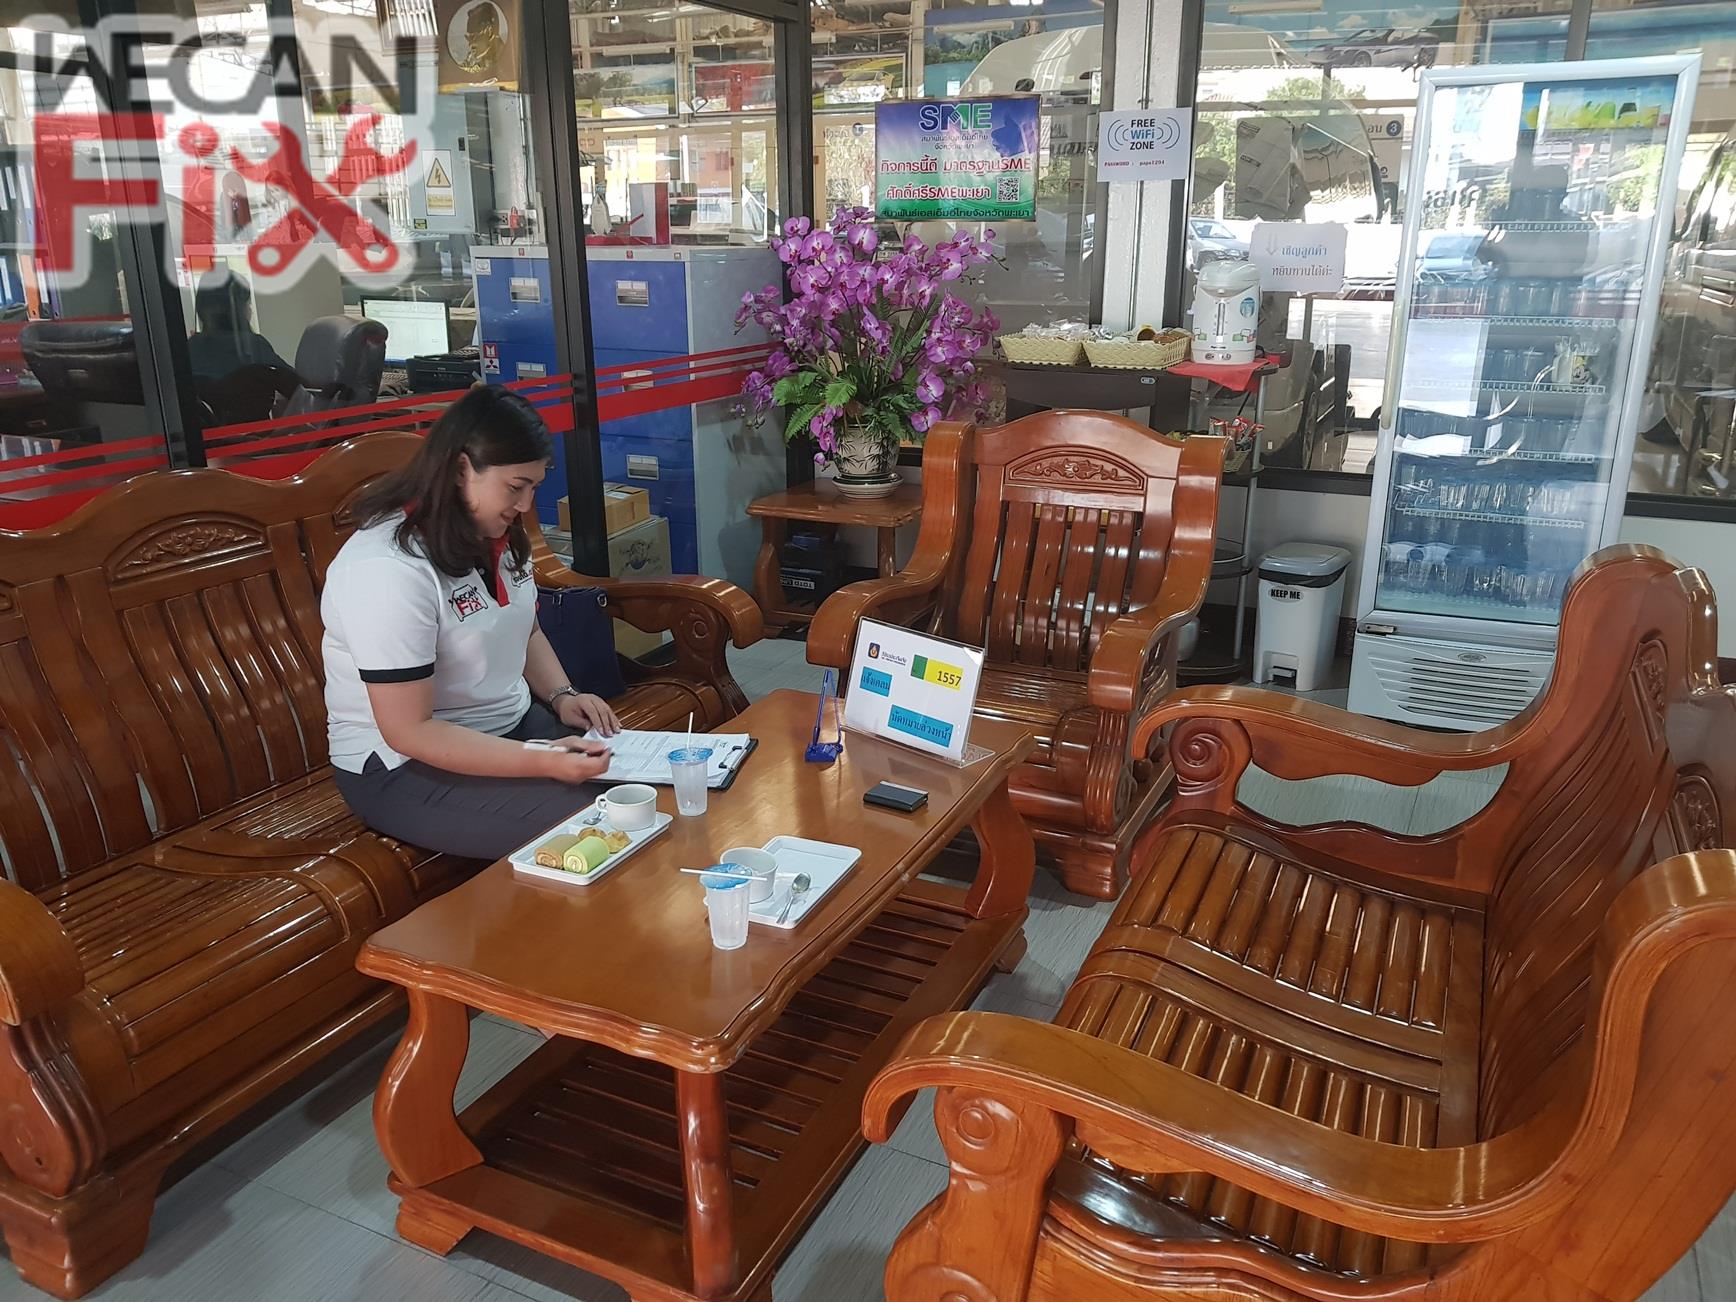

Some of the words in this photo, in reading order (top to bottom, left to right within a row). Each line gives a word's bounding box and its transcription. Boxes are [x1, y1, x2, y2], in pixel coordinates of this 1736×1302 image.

[919, 102, 992, 132] SME
[1130, 118, 1156, 128] FREE
[1130, 129, 1155, 140] WiFi
[1129, 141, 1155, 150] ZONE
[881, 154, 938, 172] กิจการนี้ดี
[1281, 244, 1327, 258] เชิญลูกค้า
[1270, 589, 1288, 598] KEEP
[1289, 591, 1301, 599] ME
[936, 670, 962, 687] 1557
